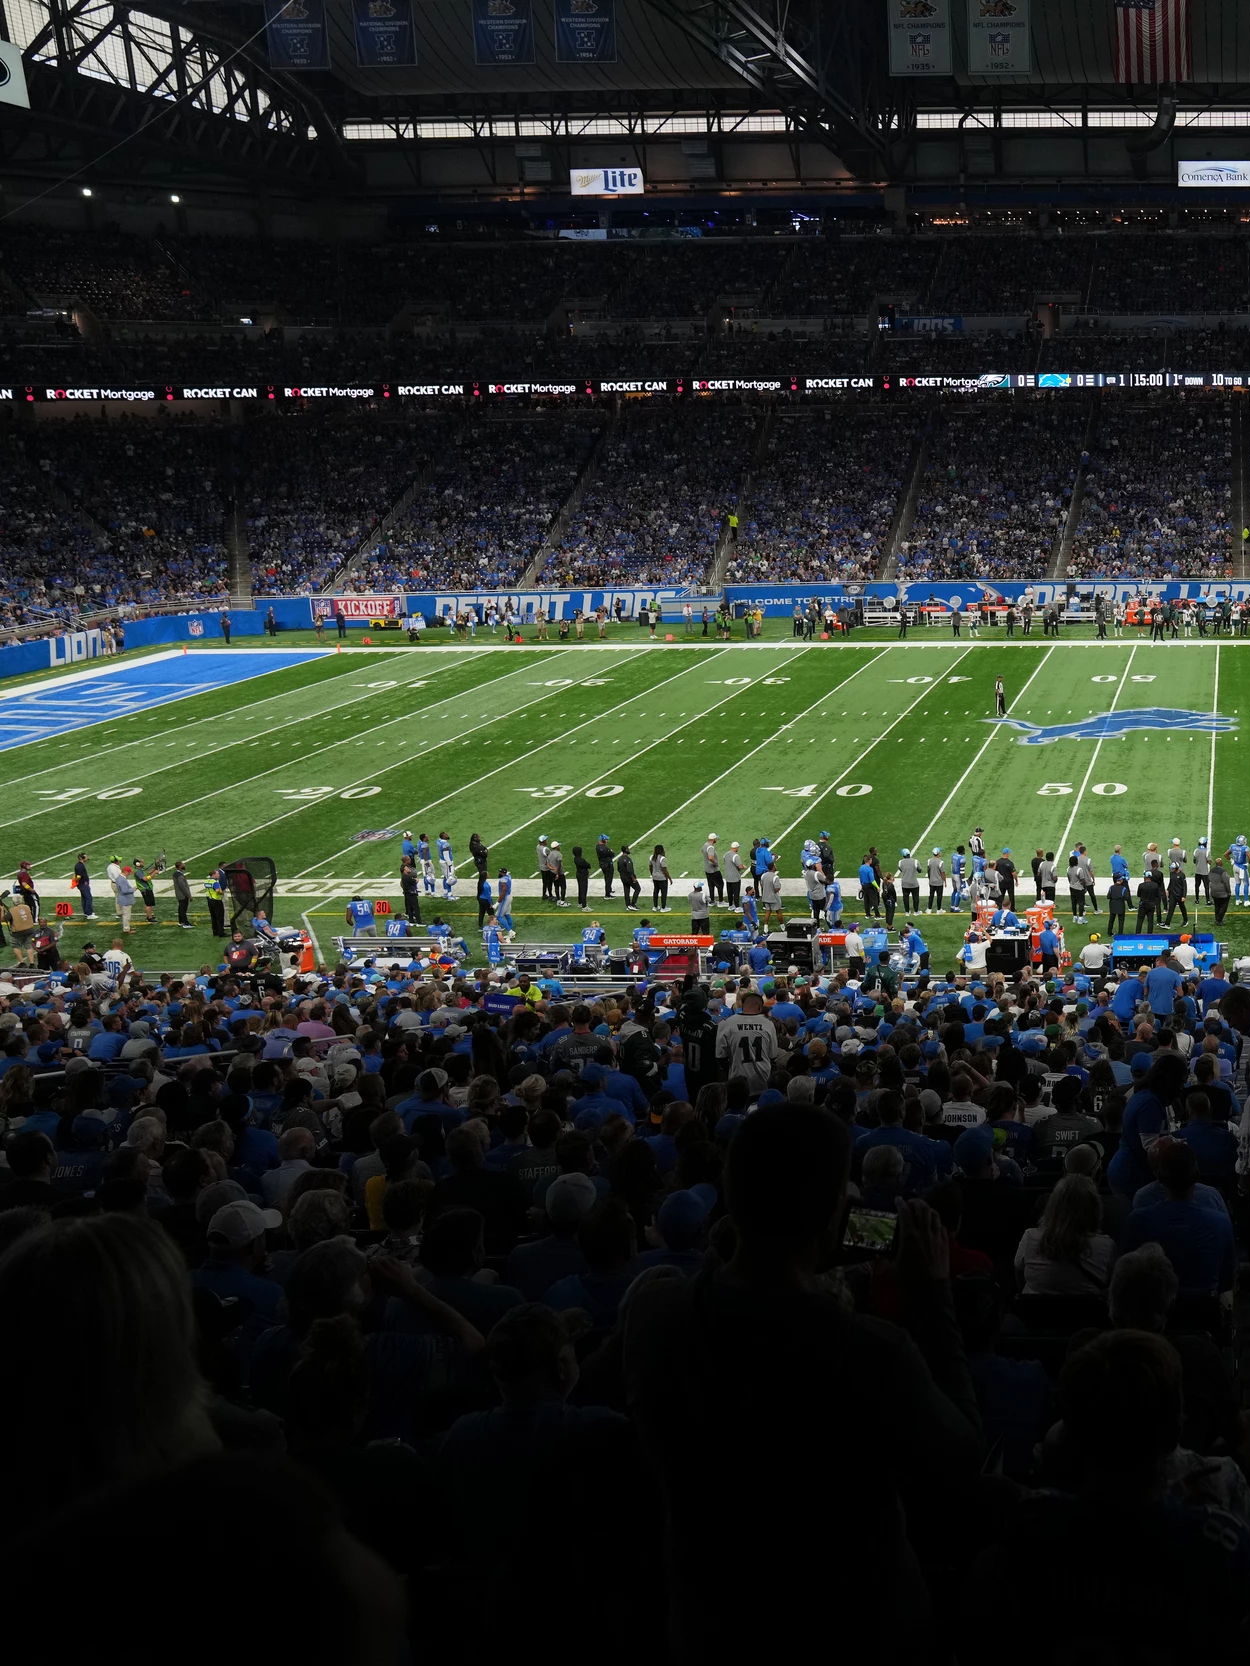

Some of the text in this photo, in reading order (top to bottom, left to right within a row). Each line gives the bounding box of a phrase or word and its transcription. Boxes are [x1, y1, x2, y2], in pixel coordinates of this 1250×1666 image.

[602, 170, 638, 192] Lite
[692, 380, 781, 390] ROCKET Mortgage
[806, 378, 873, 388] ROCKET CAN
[900, 378, 942, 386] ROCKET
[1018, 375, 1024, 386] 0
[1077, 375, 1083, 386] 0
[1119, 375, 1125, 386] 1
[1135, 375, 1162, 386] 15:00
[1185, 377, 1203, 385] DOWN
[1212, 374, 1242, 386] 10 TO GO
[398, 385, 464, 395] ROCKET CAN
[489, 384, 575, 394] ROCKET Mortgage
[600, 381, 667, 392] ROCKET CAN
[46, 389, 154, 400] ROCKET Mortgage
[183, 388, 256, 398] ROCKET CAN
[284, 388, 374, 398] ROCKET Mortgage
[337, 601, 391, 615] KICKOFF
[1092, 674, 1156, 683] 50
[284, 785, 382, 800] 20
[530, 784, 624, 799] 30
[782, 783, 874, 797] 40
[1036, 782, 1128, 796] 50
[57, 904, 69, 915] 20
[376, 902, 388, 913] 30
[875, 978, 881, 990] 6
[570, 1046, 598, 1055] SANDERS
[739, 1036, 764, 1064] 11
[1093, 1095, 1102, 1112] 6
[944, 1114, 978, 1123] JOHNSON
[1055, 1131, 1079, 1140] SWIFT
[52, 1165, 84, 1178] JONES
